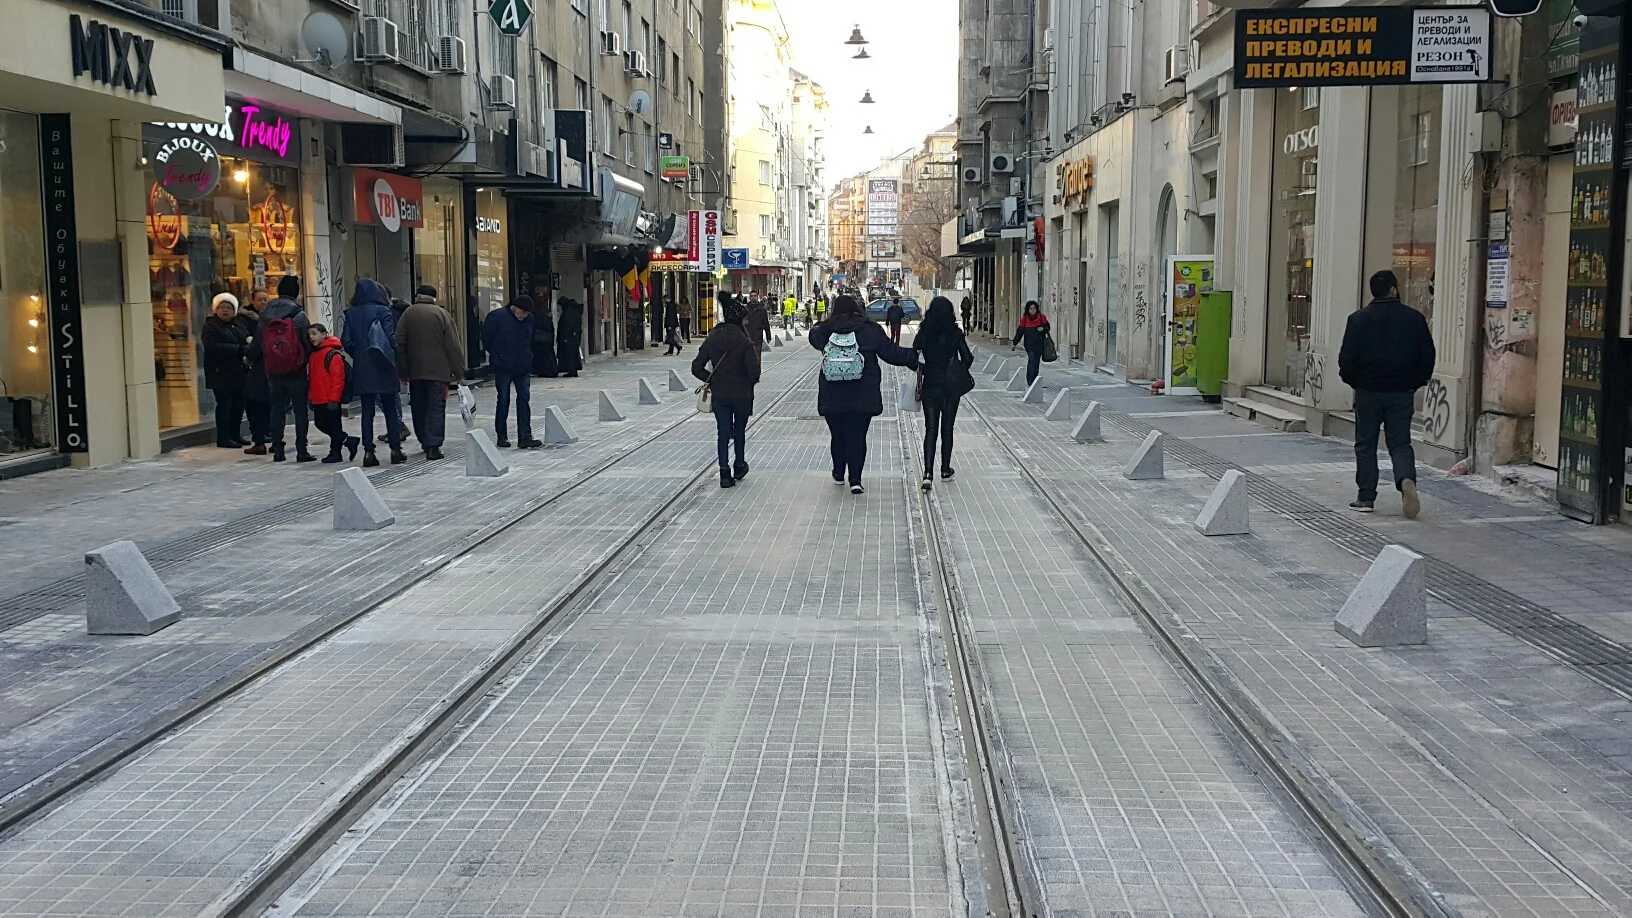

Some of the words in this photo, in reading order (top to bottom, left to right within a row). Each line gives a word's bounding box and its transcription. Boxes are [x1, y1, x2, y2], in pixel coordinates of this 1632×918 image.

[1246, 17, 1377, 35] ЕКСПРЕСНИ
[1418, 16, 1454, 25] ЦЕНТЪР
[1418, 26, 1461, 35] ПРЕВОДИ
[1464, 26, 1471, 34] И
[1246, 39, 1352, 58] ПРЕВОДИ
[1357, 38, 1371, 54] И
[1417, 36, 1482, 46] ЛЕГАЛИЗАЦИИ
[70, 14, 157, 96] MIXX
[1417, 51, 1463, 62] РЕЗОН
[1245, 60, 1406, 78] ЛЕГАЛИЗАЦИЯ
[241, 106, 290, 157] Trendy
[156, 137, 214, 163] BIJOUX
[52, 131, 66, 212] Вашите
[163, 165, 211, 191] Trendy
[377, 192, 396, 218] TBI
[400, 197, 421, 221] Bank
[705, 211, 718, 235] GSM
[57, 228, 69, 311] Обувки
